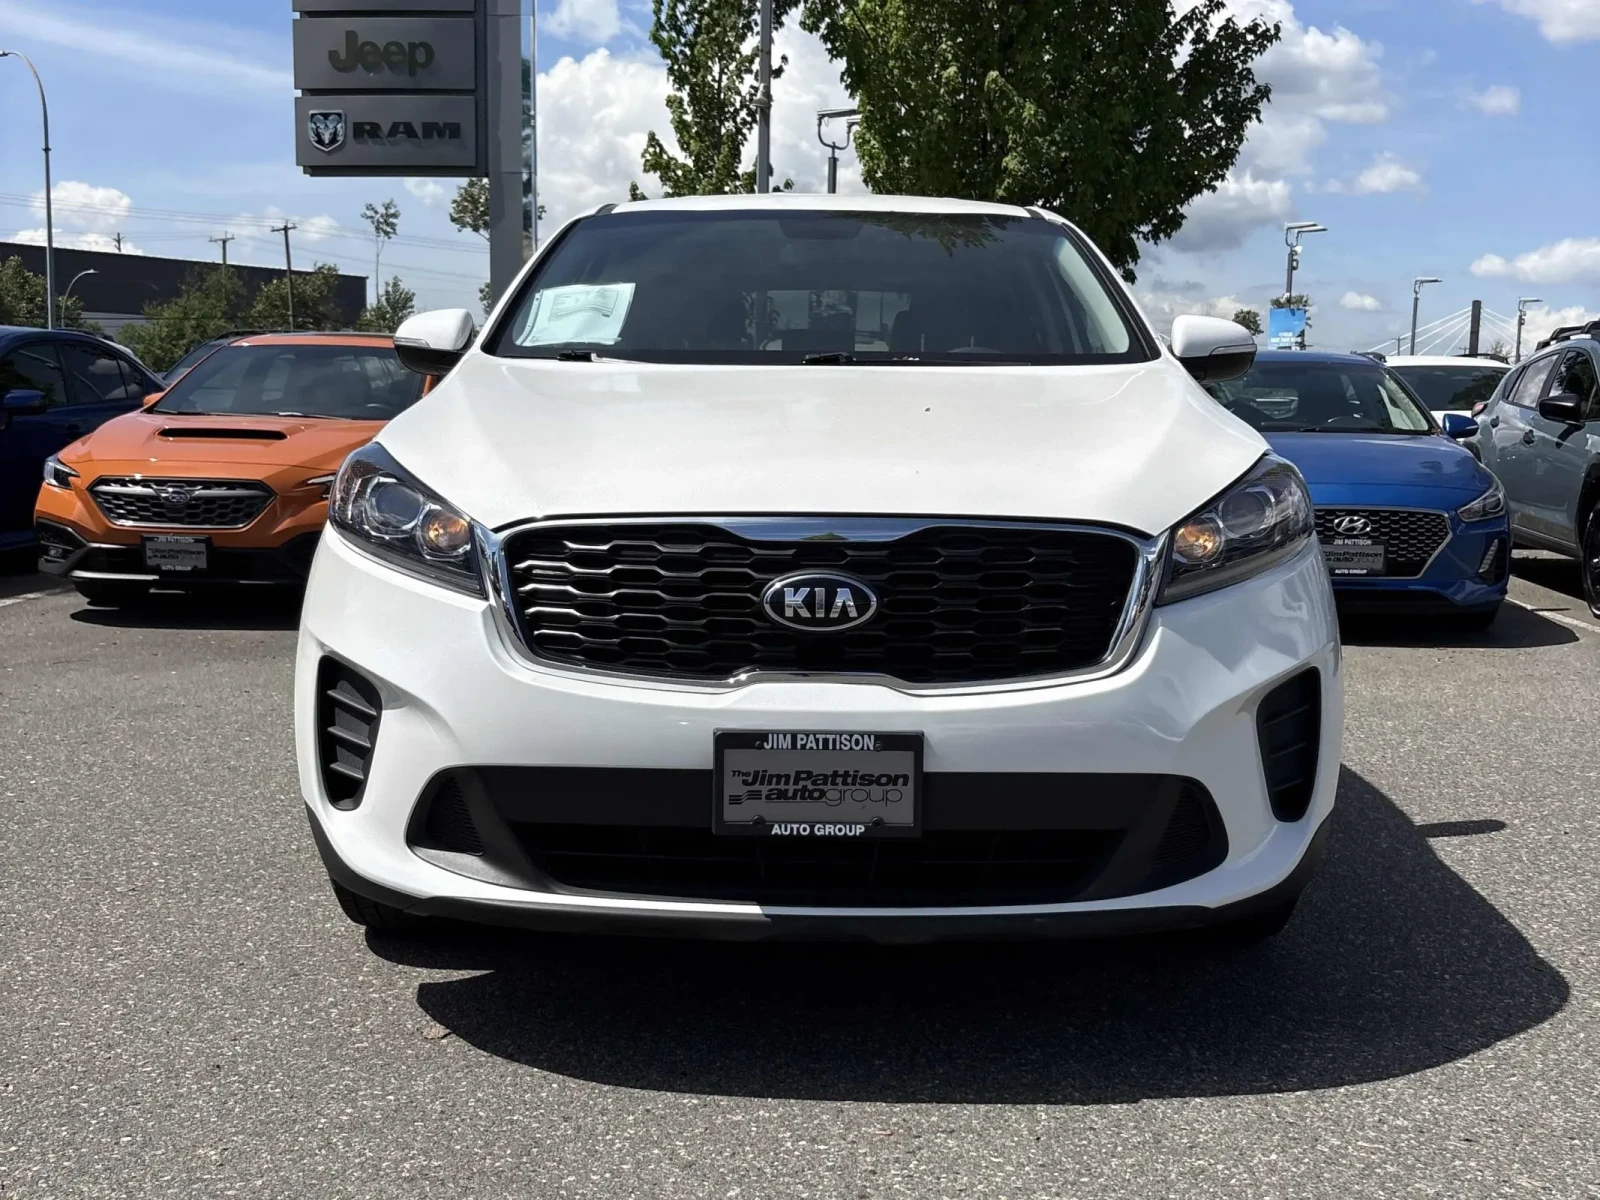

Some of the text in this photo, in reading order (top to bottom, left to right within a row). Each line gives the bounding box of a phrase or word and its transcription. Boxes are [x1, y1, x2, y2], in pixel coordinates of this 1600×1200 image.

[328, 30, 435, 77] Jeep
[352, 121, 461, 140] RAM
[784, 587, 859, 618] KIA
[763, 734, 875, 751] JIM PATTISON
[731, 769, 910, 787] The Jim Pattison
[771, 824, 866, 836] AUTO GROUP
